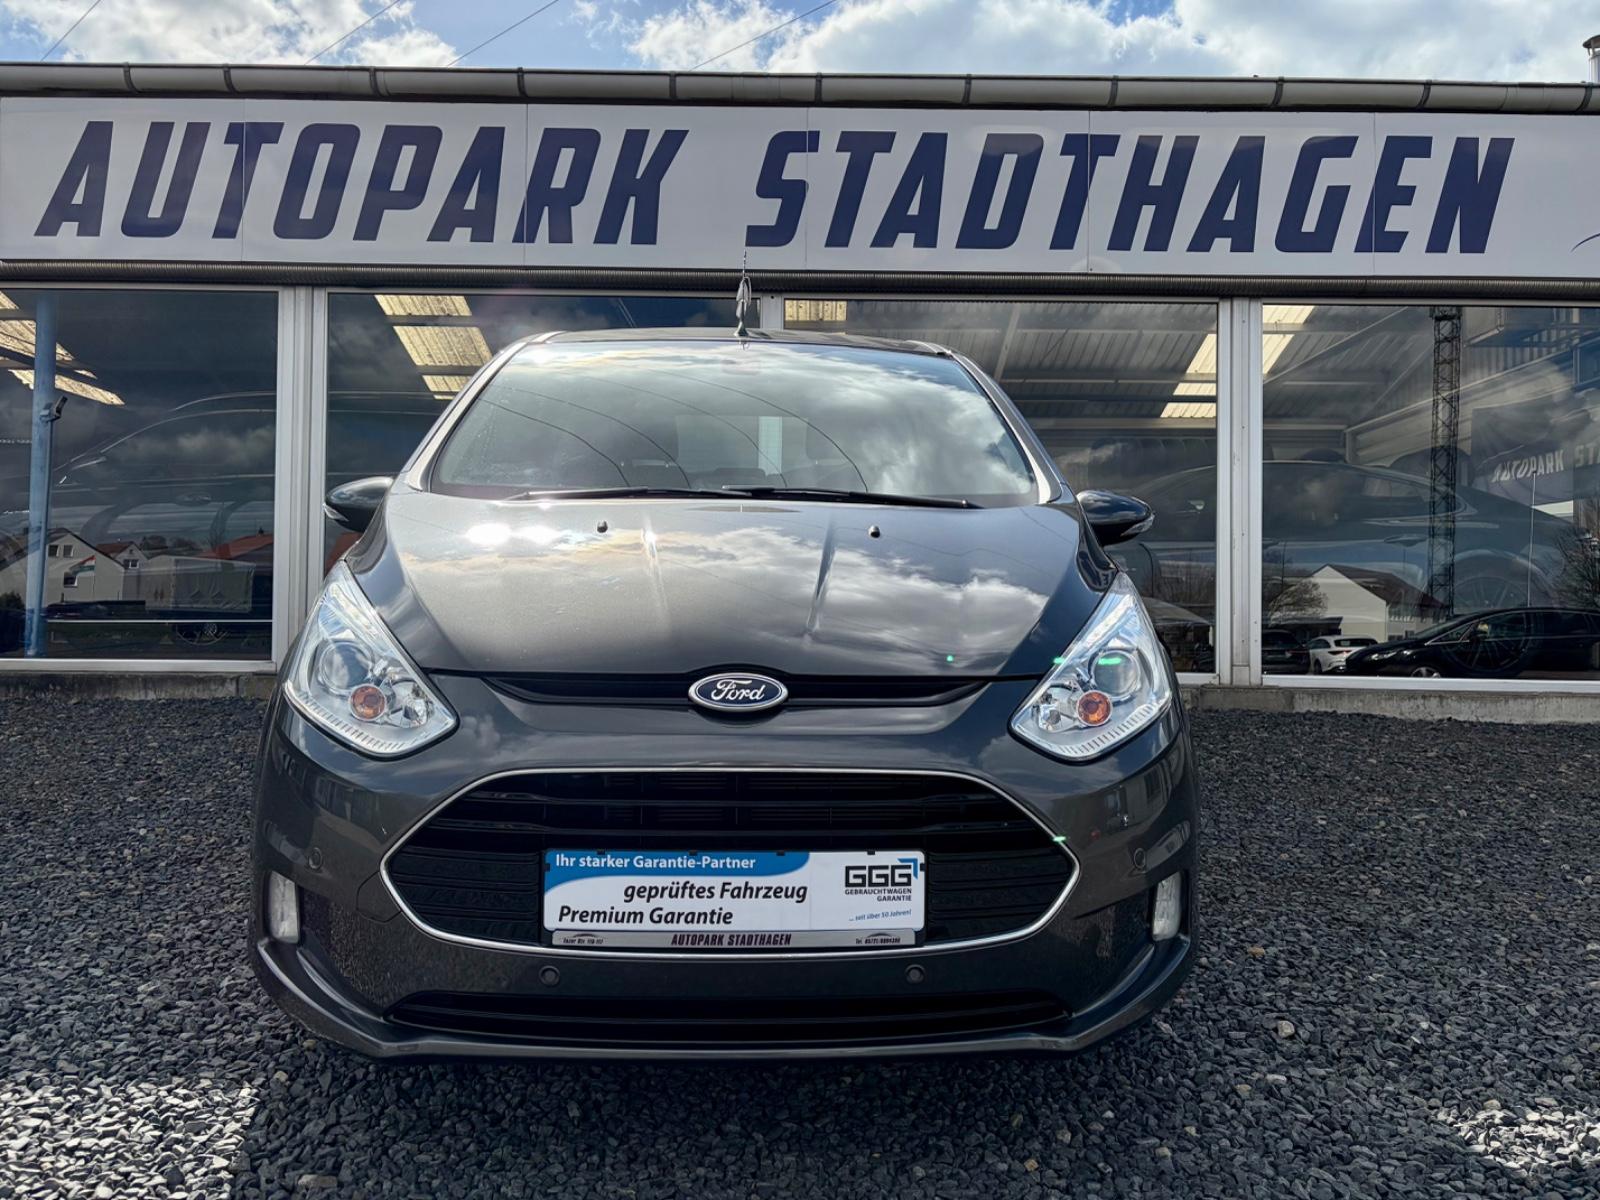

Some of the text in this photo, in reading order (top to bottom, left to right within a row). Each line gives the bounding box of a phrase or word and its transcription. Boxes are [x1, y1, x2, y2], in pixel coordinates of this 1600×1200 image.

[34, 120, 1515, 254] AUTOPARK STADTHAGEN
[1491, 449, 1565, 482] AUTOPARK
[711, 679, 766, 701] Ford
[556, 854, 756, 869] Ihr starker Garantie-Partner
[845, 865, 912, 888] GGG
[623, 881, 808, 903] geprüftes Fahrzeug
[558, 905, 733, 924] Premium Garantie
[671, 933, 792, 946] AUTOPARK STADTHAGEN
